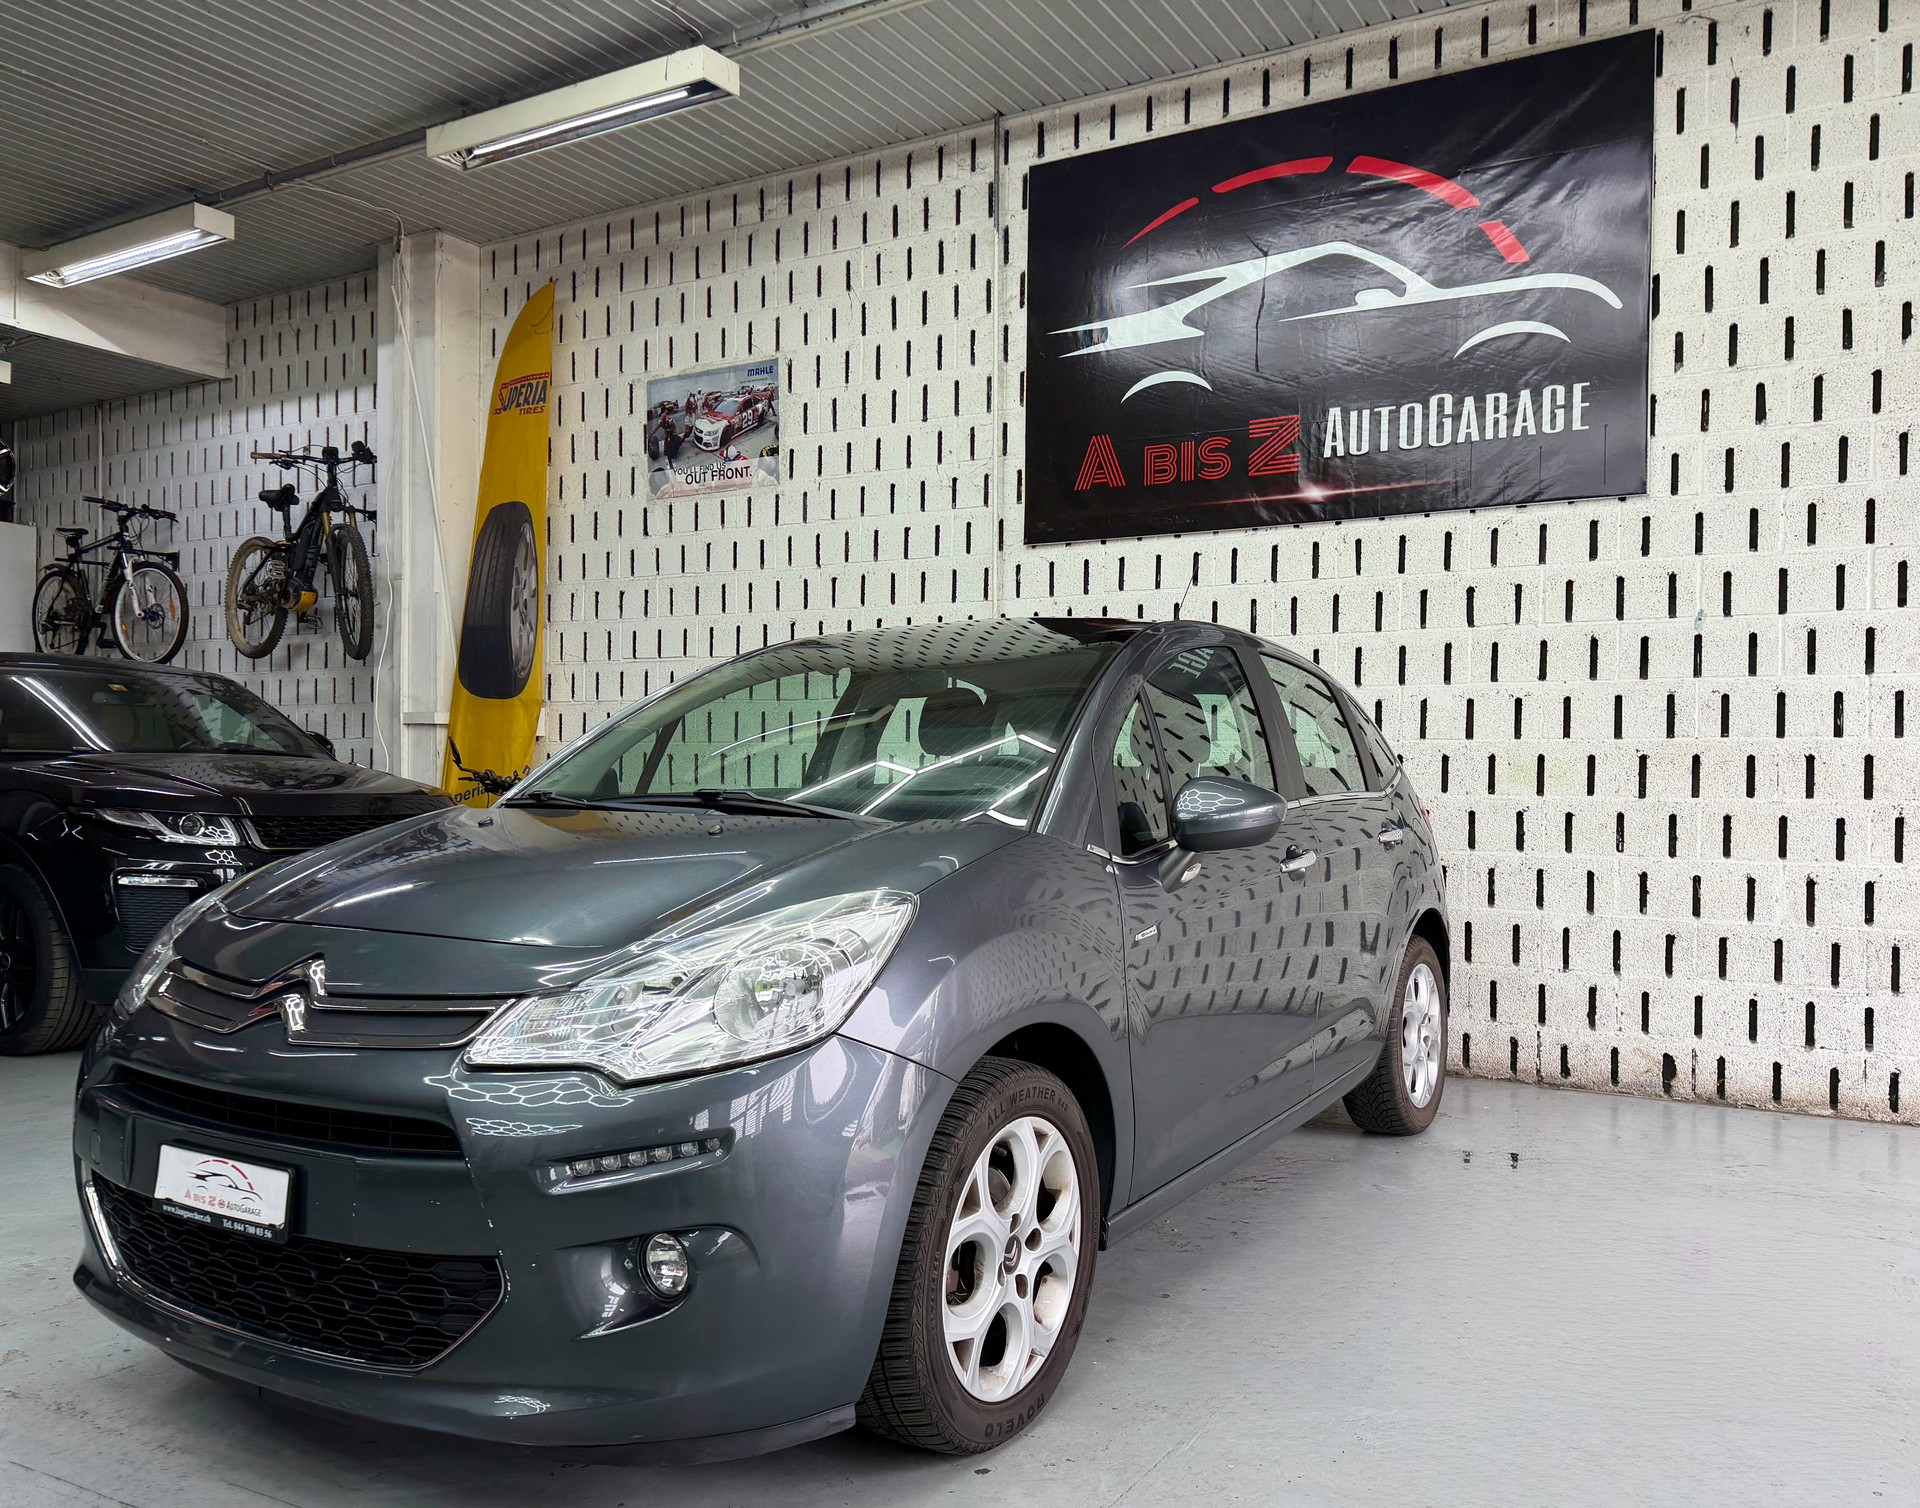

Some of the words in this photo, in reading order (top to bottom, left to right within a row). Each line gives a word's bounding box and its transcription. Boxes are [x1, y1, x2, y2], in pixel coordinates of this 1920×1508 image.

[747, 365, 774, 377] MAHLE
[519, 405, 546, 416] TIRES
[1074, 434, 1126, 491] A
[1143, 436, 1232, 487] BIS
[1248, 413, 1300, 477] Z
[700, 463, 715, 471] FIND
[717, 462, 726, 470] US
[685, 471, 708, 485] OUT
[711, 465, 752, 481] FRONT.
[987, 1102, 1006, 1129] ALL
[1009, 1086, 1056, 1107] WEATHER
[184, 1189, 191, 1199] A
[984, 1392, 1045, 1438] ROVELO
